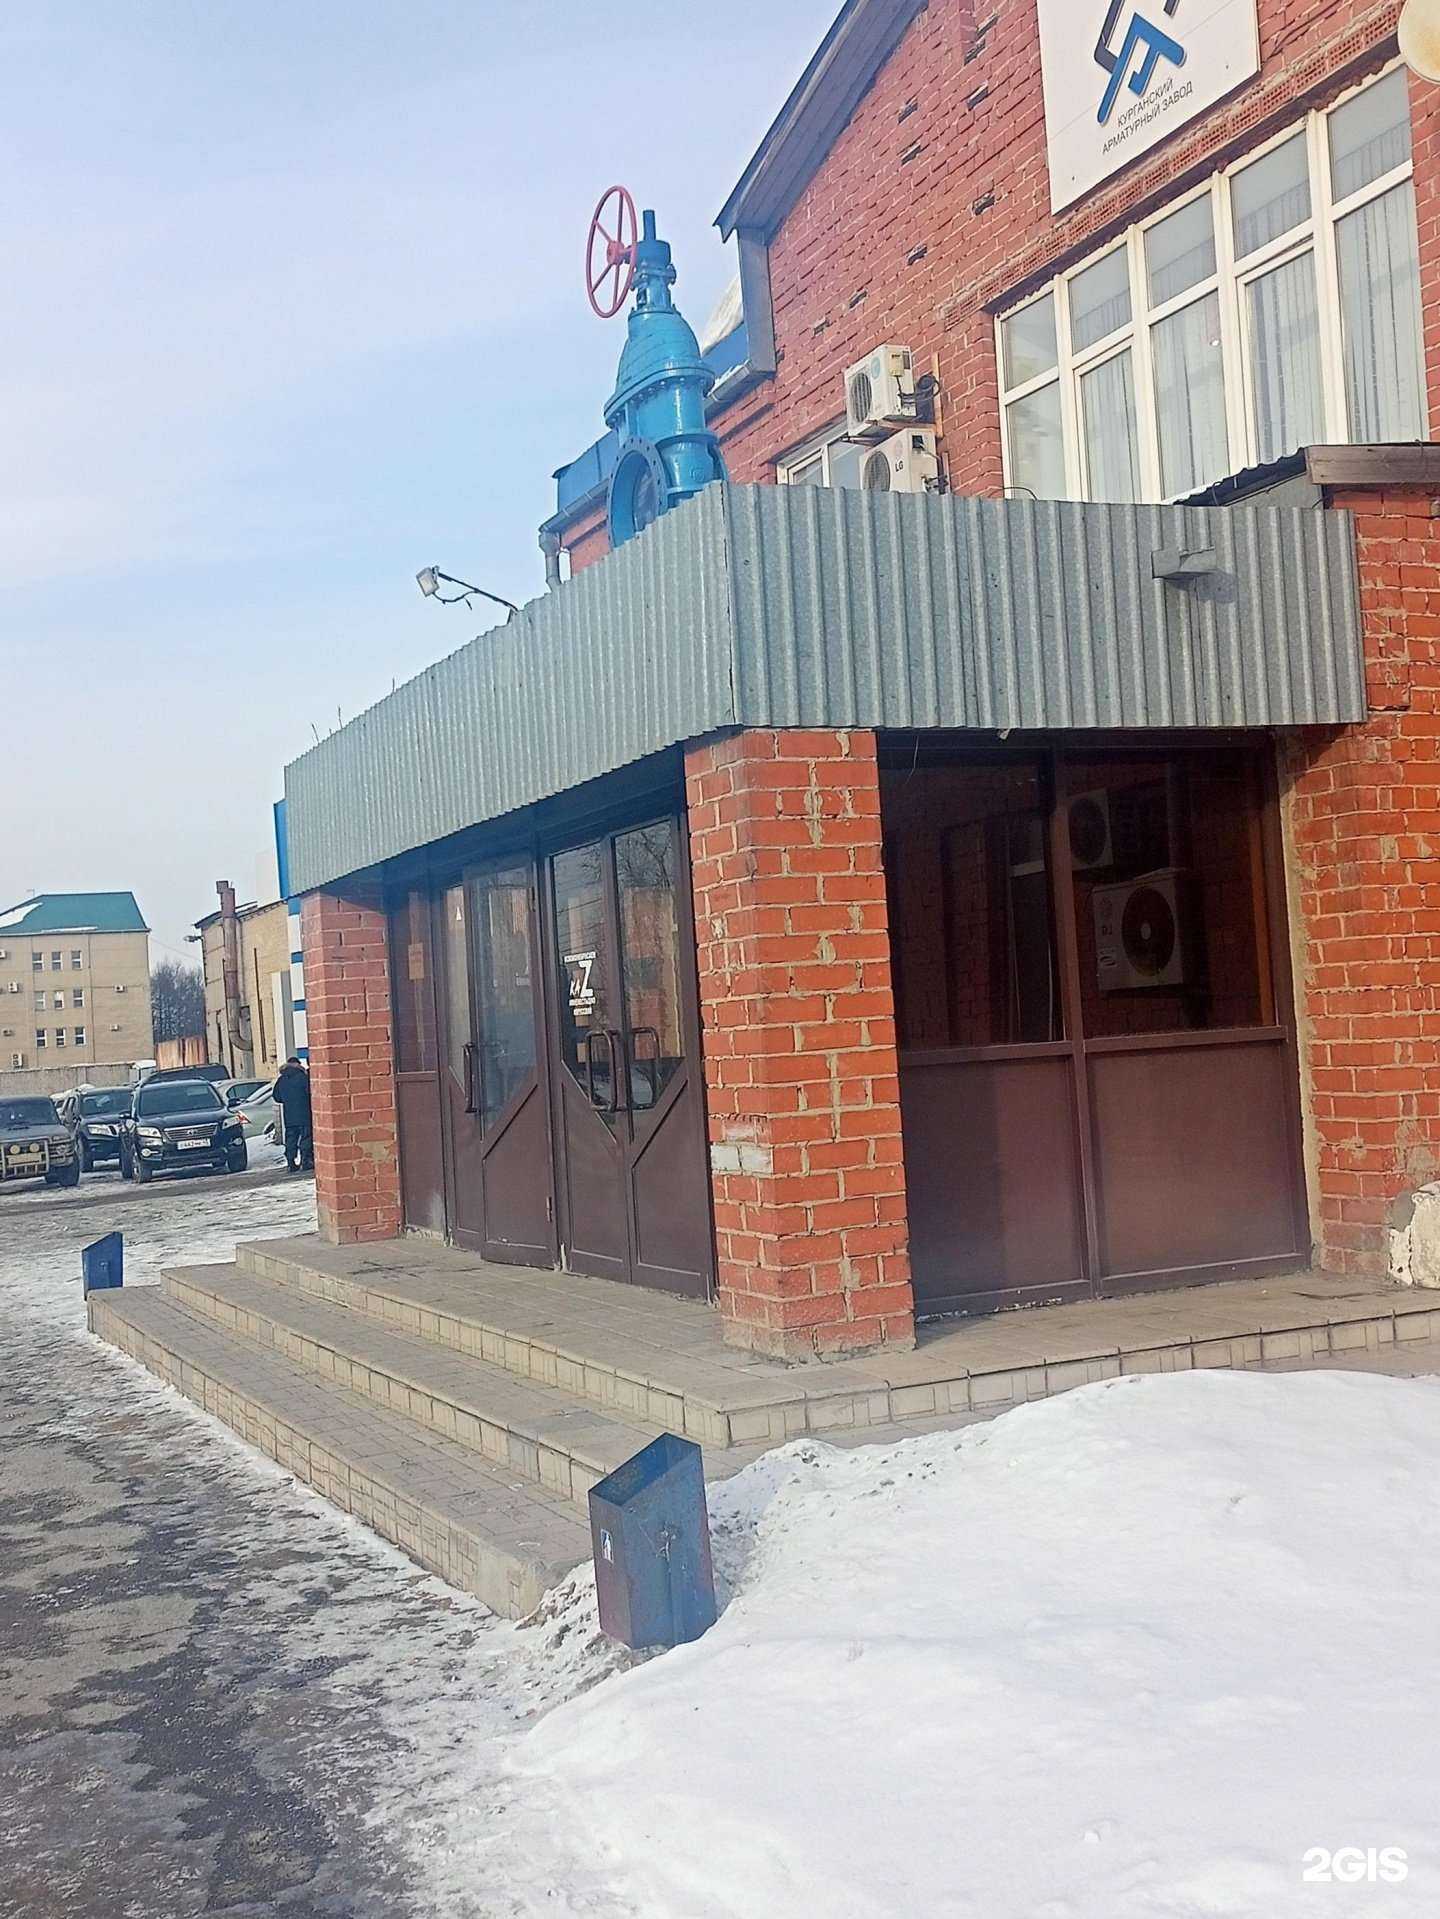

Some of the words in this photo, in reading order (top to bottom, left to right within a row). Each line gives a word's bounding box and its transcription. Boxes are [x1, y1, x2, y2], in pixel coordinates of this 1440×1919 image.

[1102, 103, 1162, 154] АРМАТУРНЫЙ
[1162, 80, 1193, 112] ЗАВОД
[1117, 77, 1173, 128] КУРГАНСКИЙ
[895, 460, 904, 472] LG
